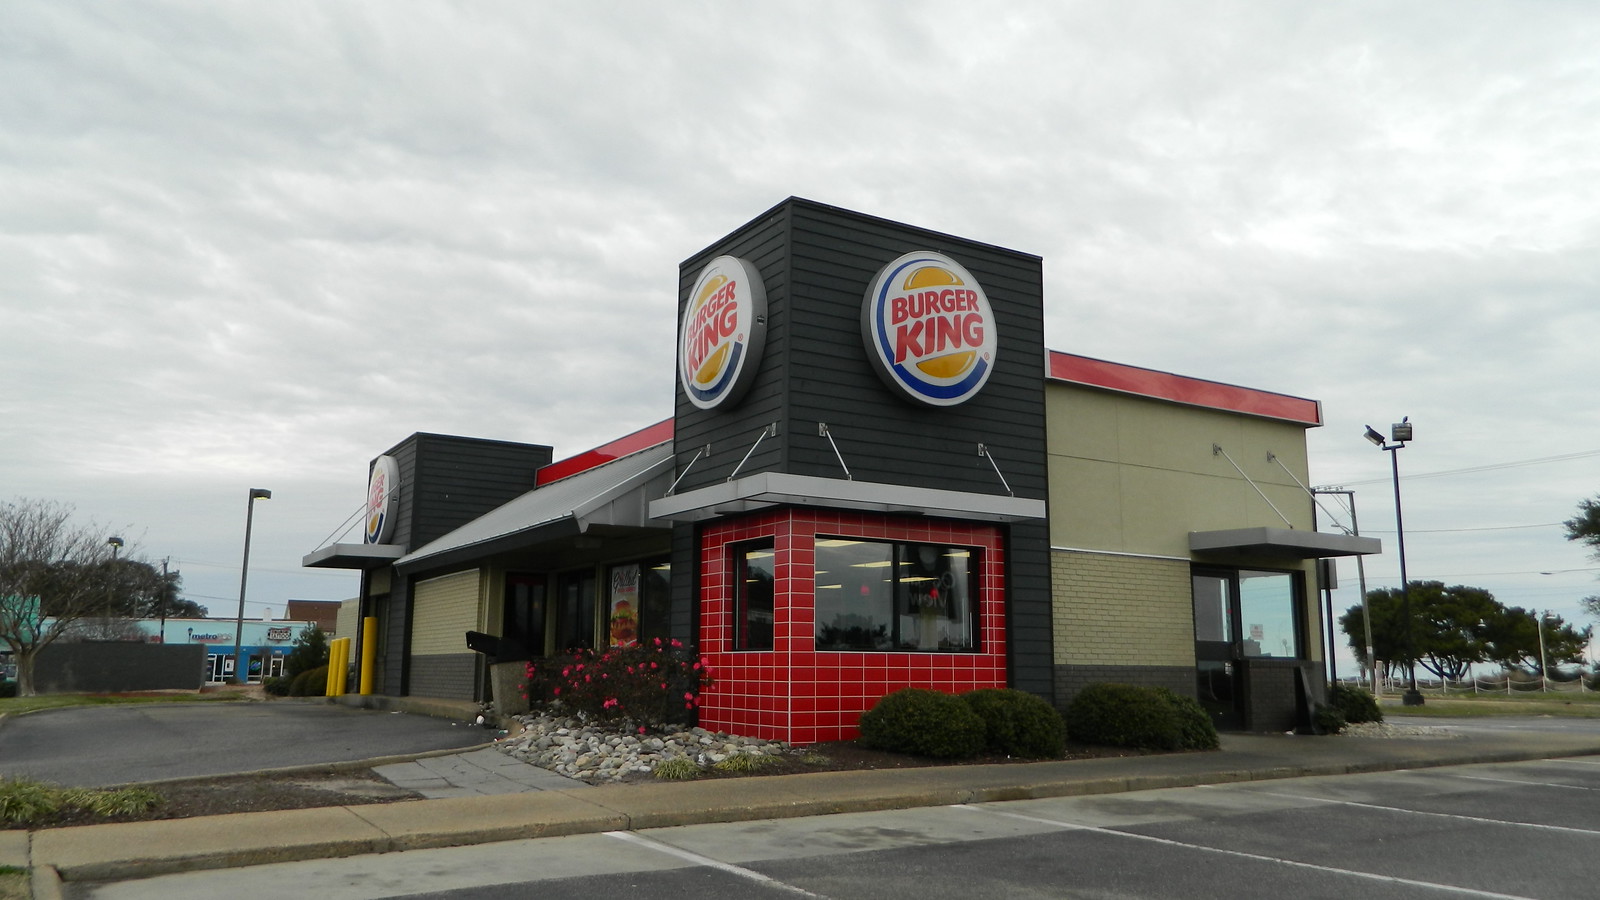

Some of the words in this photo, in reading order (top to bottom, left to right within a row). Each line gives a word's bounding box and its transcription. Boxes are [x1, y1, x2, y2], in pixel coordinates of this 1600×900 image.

[687, 280, 736, 350] BURGER
[891, 289, 980, 325] BURGER
[688, 301, 738, 384] KING
[895, 313, 984, 364] KING
